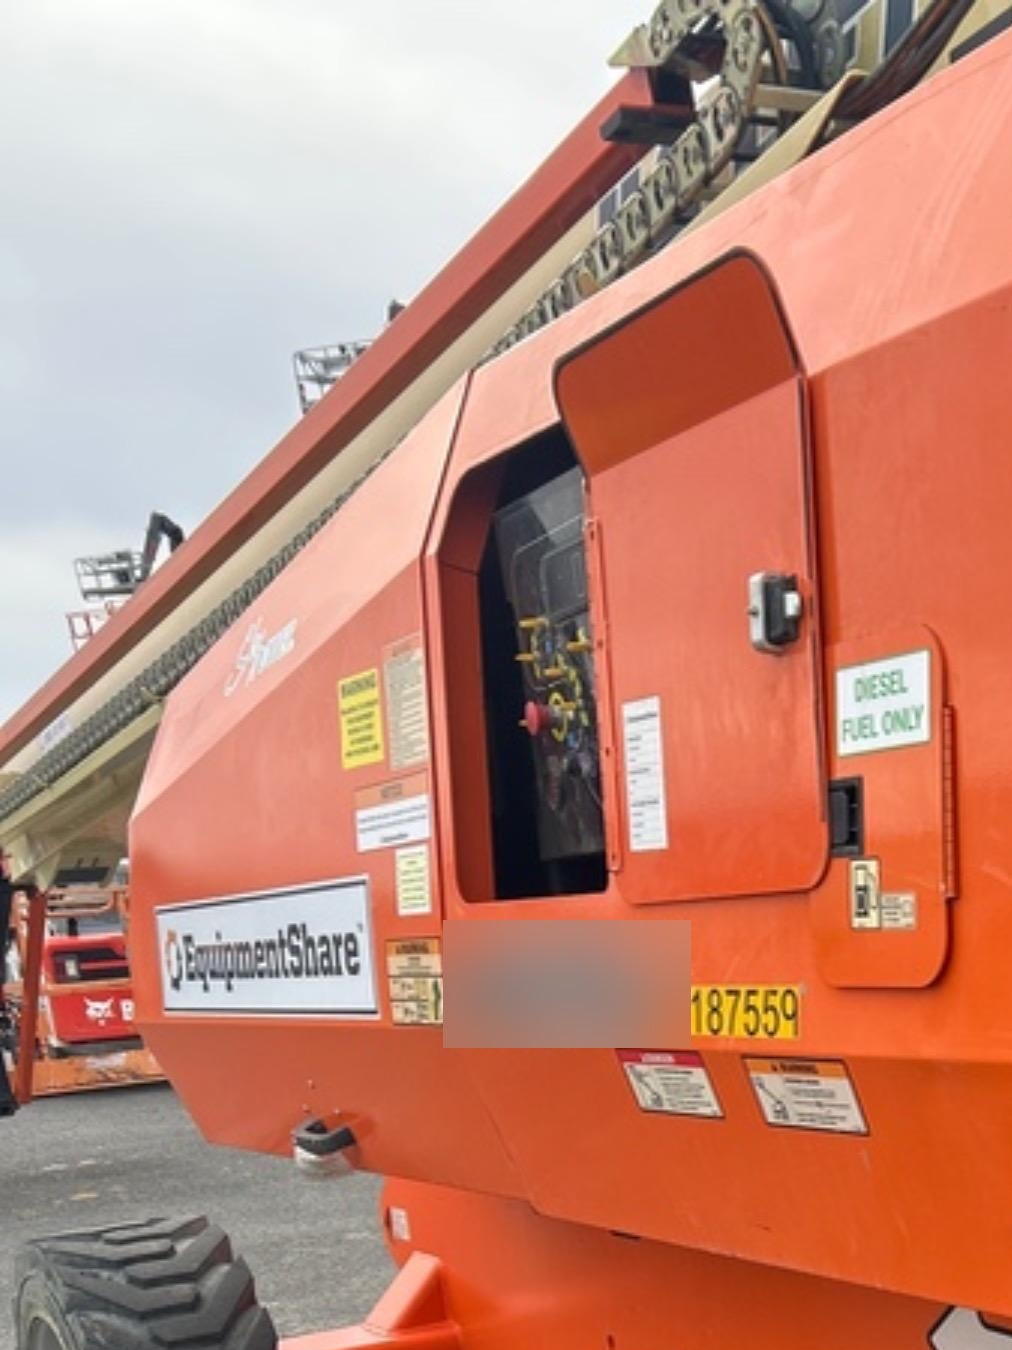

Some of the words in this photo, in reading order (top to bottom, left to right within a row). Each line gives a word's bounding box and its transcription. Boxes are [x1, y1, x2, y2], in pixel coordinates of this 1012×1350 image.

[855, 669, 909, 703] DIESEL
[842, 713, 879, 743] FUEL
[882, 704, 924, 737] ONLY
[182, 922, 362, 993] EquipmentShare
[692, 988, 799, 1037] 187559
